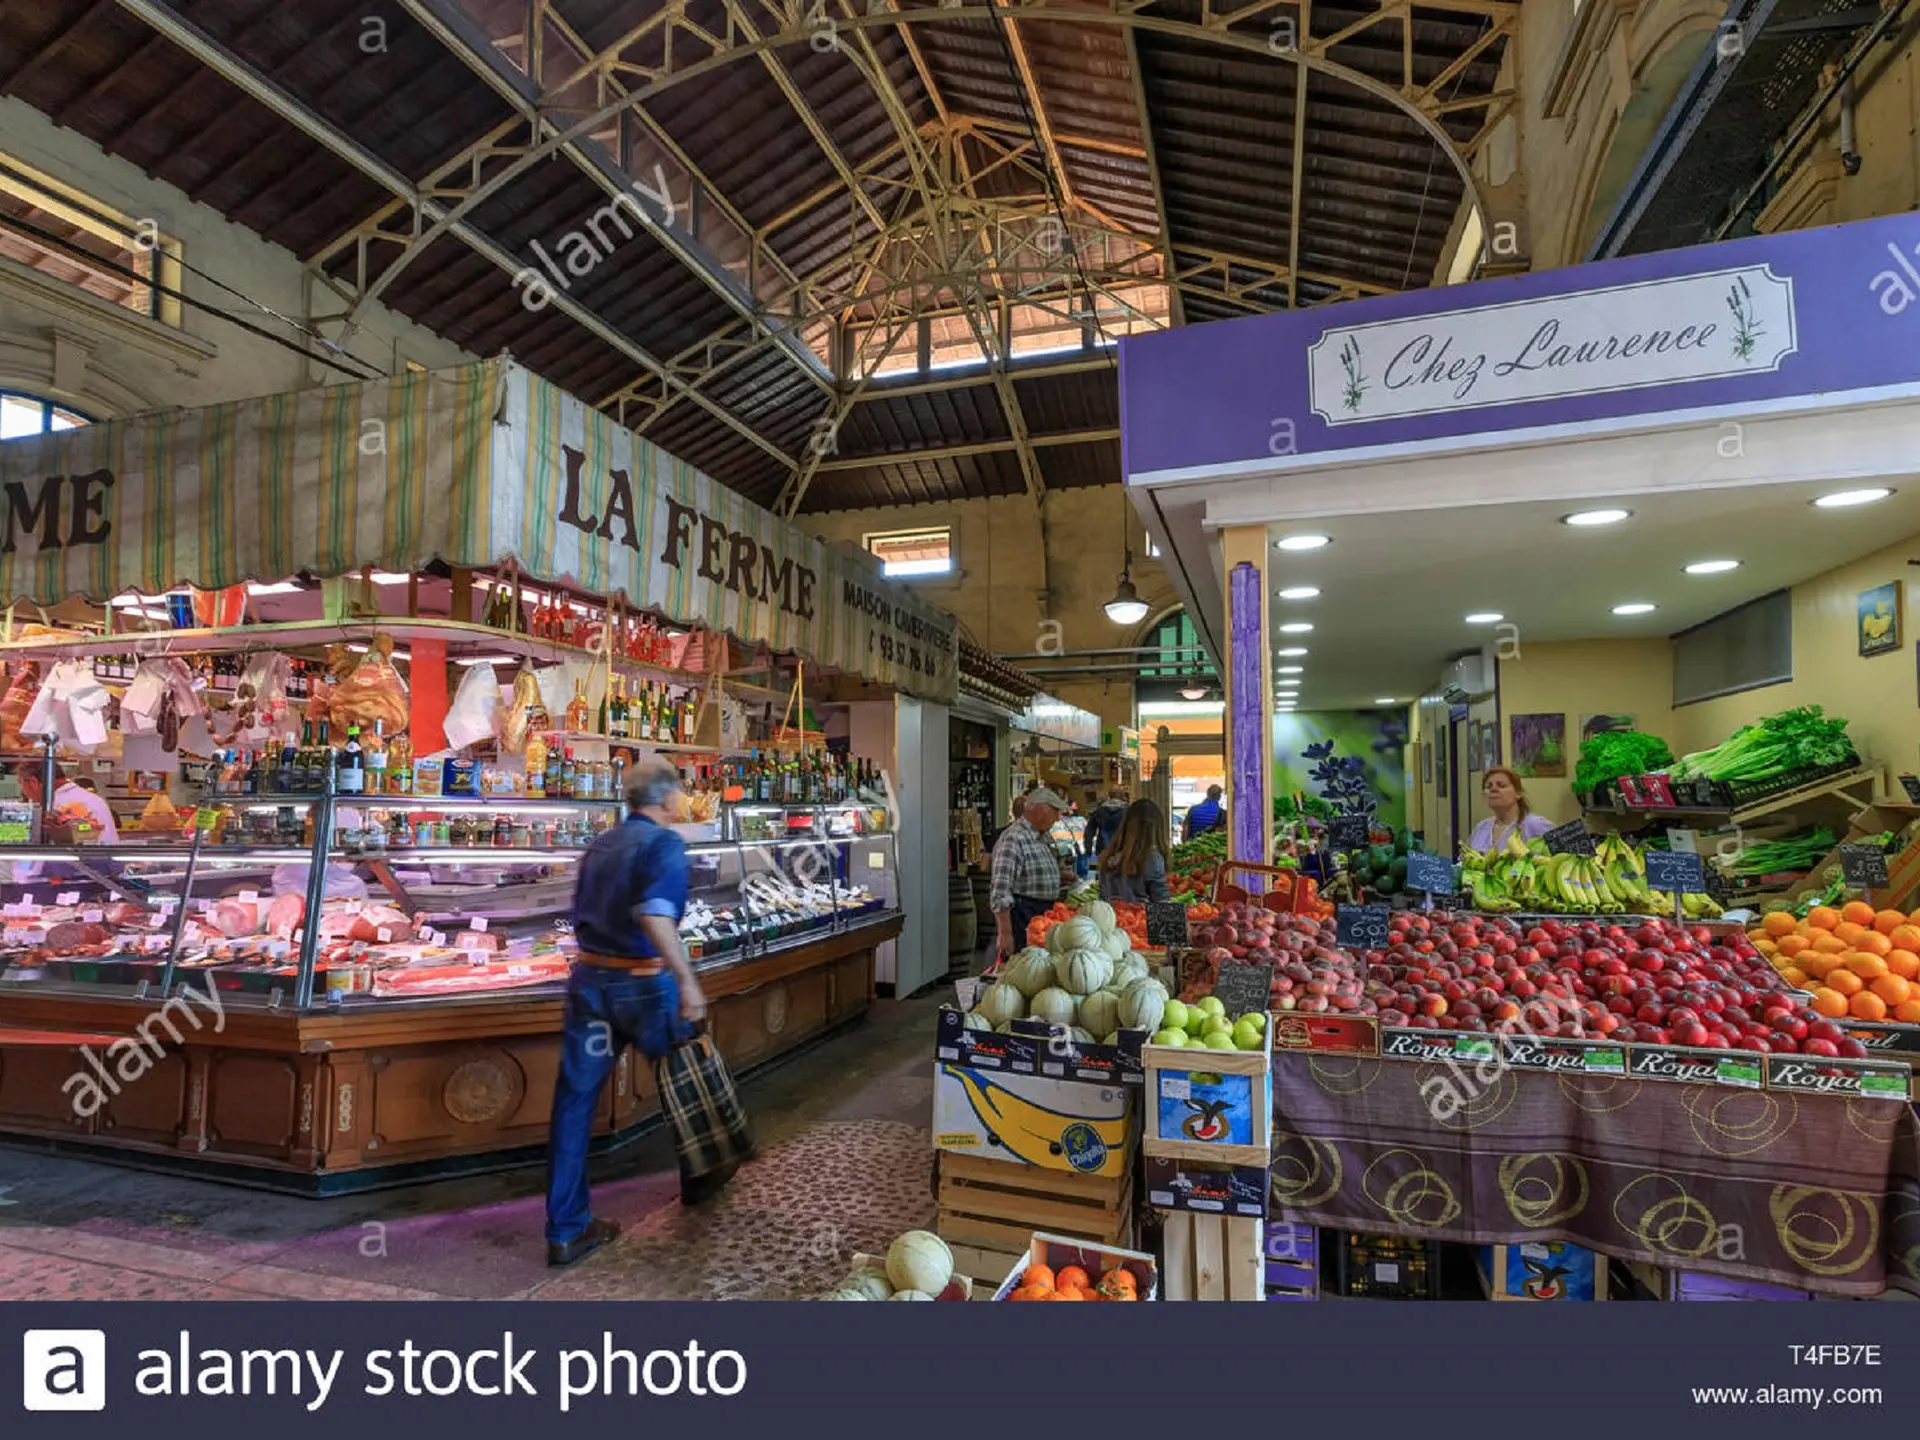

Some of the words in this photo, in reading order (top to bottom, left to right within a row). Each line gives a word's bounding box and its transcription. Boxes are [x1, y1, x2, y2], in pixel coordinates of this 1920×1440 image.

[1383, 334, 1486, 399] Chez
[1494, 318, 1717, 375] Laurence
[558, 444, 640, 552] LA
[660, 494, 816, 621] FERME
[843, 580, 891, 625] MAISON
[1389, 1035, 1457, 1061] Roya
